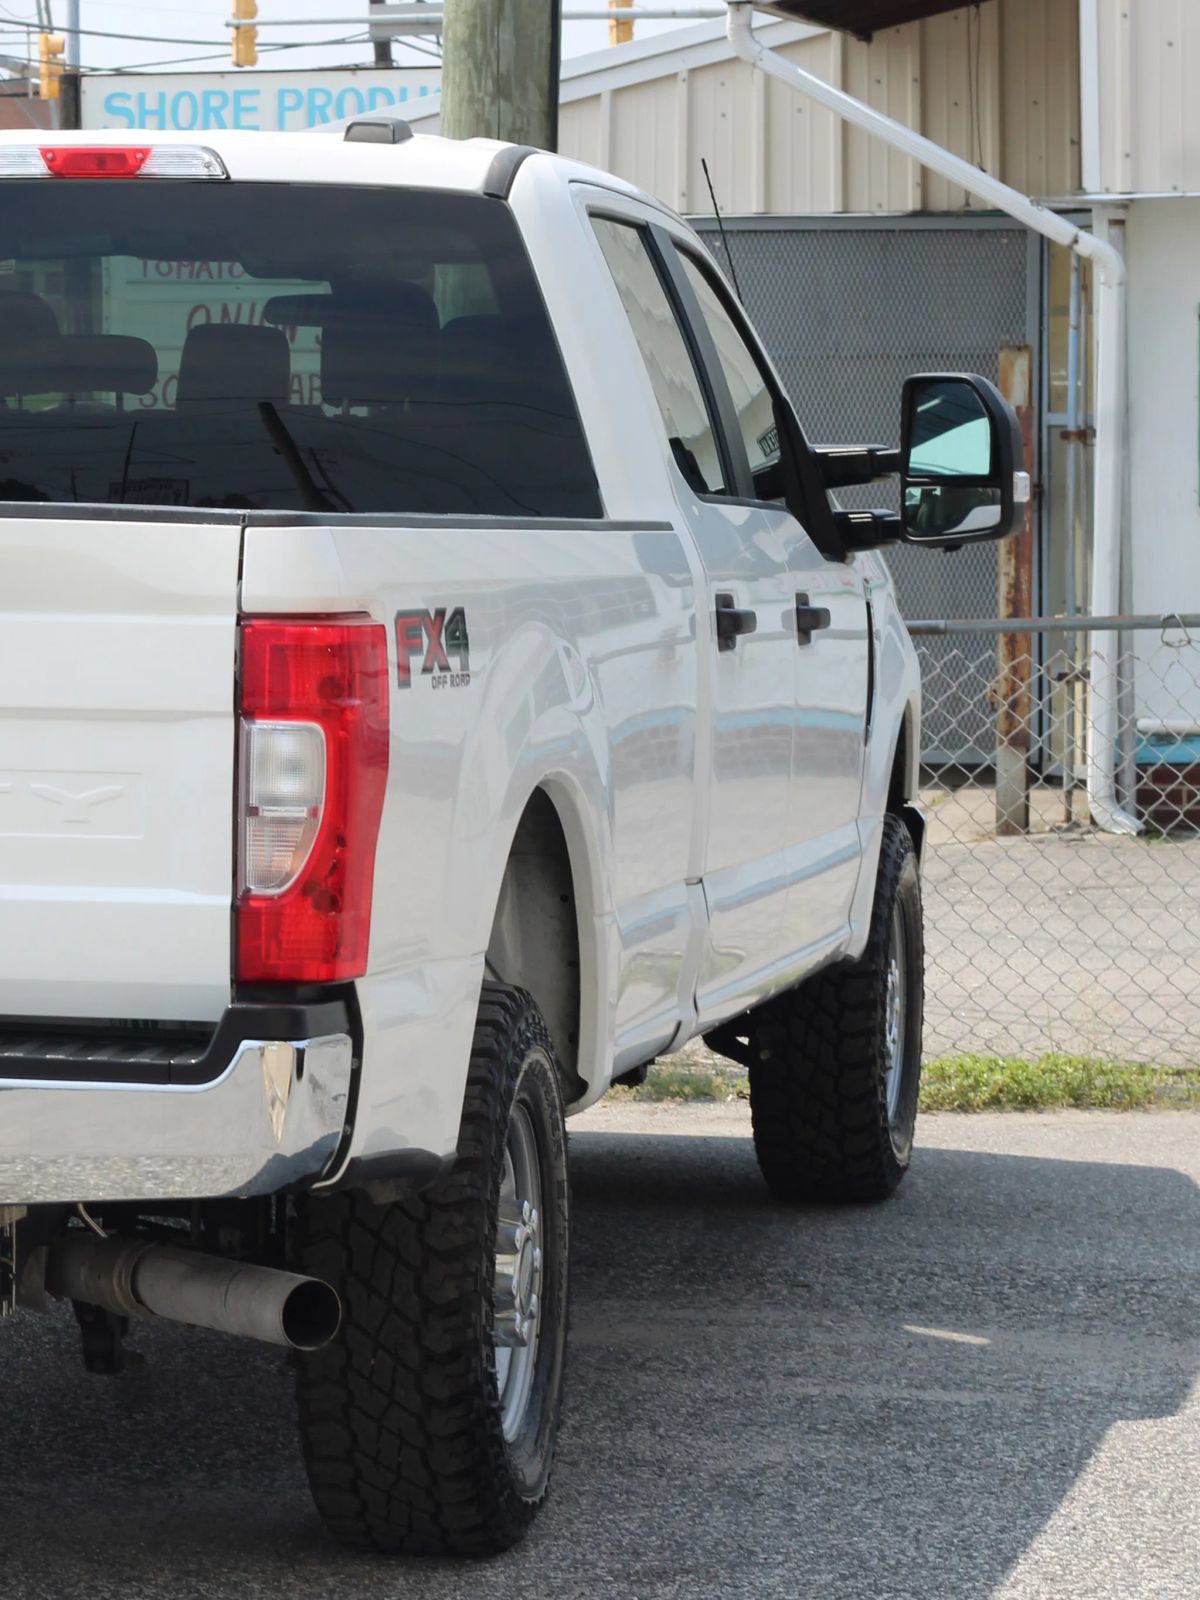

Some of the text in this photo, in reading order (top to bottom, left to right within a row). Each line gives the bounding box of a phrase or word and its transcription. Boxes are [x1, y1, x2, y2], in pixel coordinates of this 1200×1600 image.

[103, 89, 261, 130] SHORE
[394, 606, 469, 690] FX4
[431, 675, 448, 689] OFF
